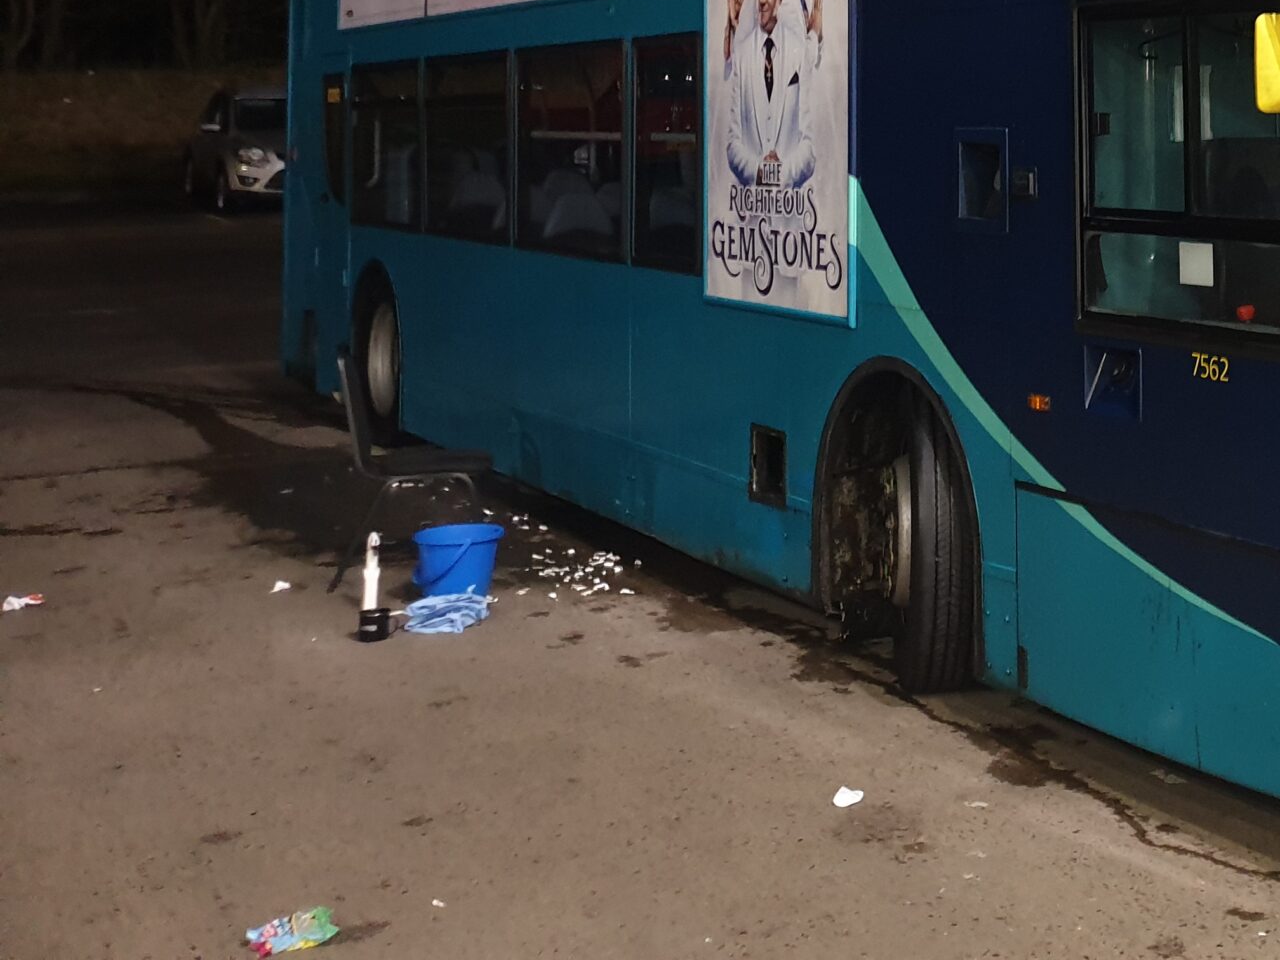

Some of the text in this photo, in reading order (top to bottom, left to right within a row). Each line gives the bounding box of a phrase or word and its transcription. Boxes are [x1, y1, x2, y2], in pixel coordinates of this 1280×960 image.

[762, 162, 783, 182] THE
[729, 184, 818, 233] RIGHTEOUS
[711, 217, 843, 297] GEMSTONES
[1191, 351, 1230, 382] 7562
